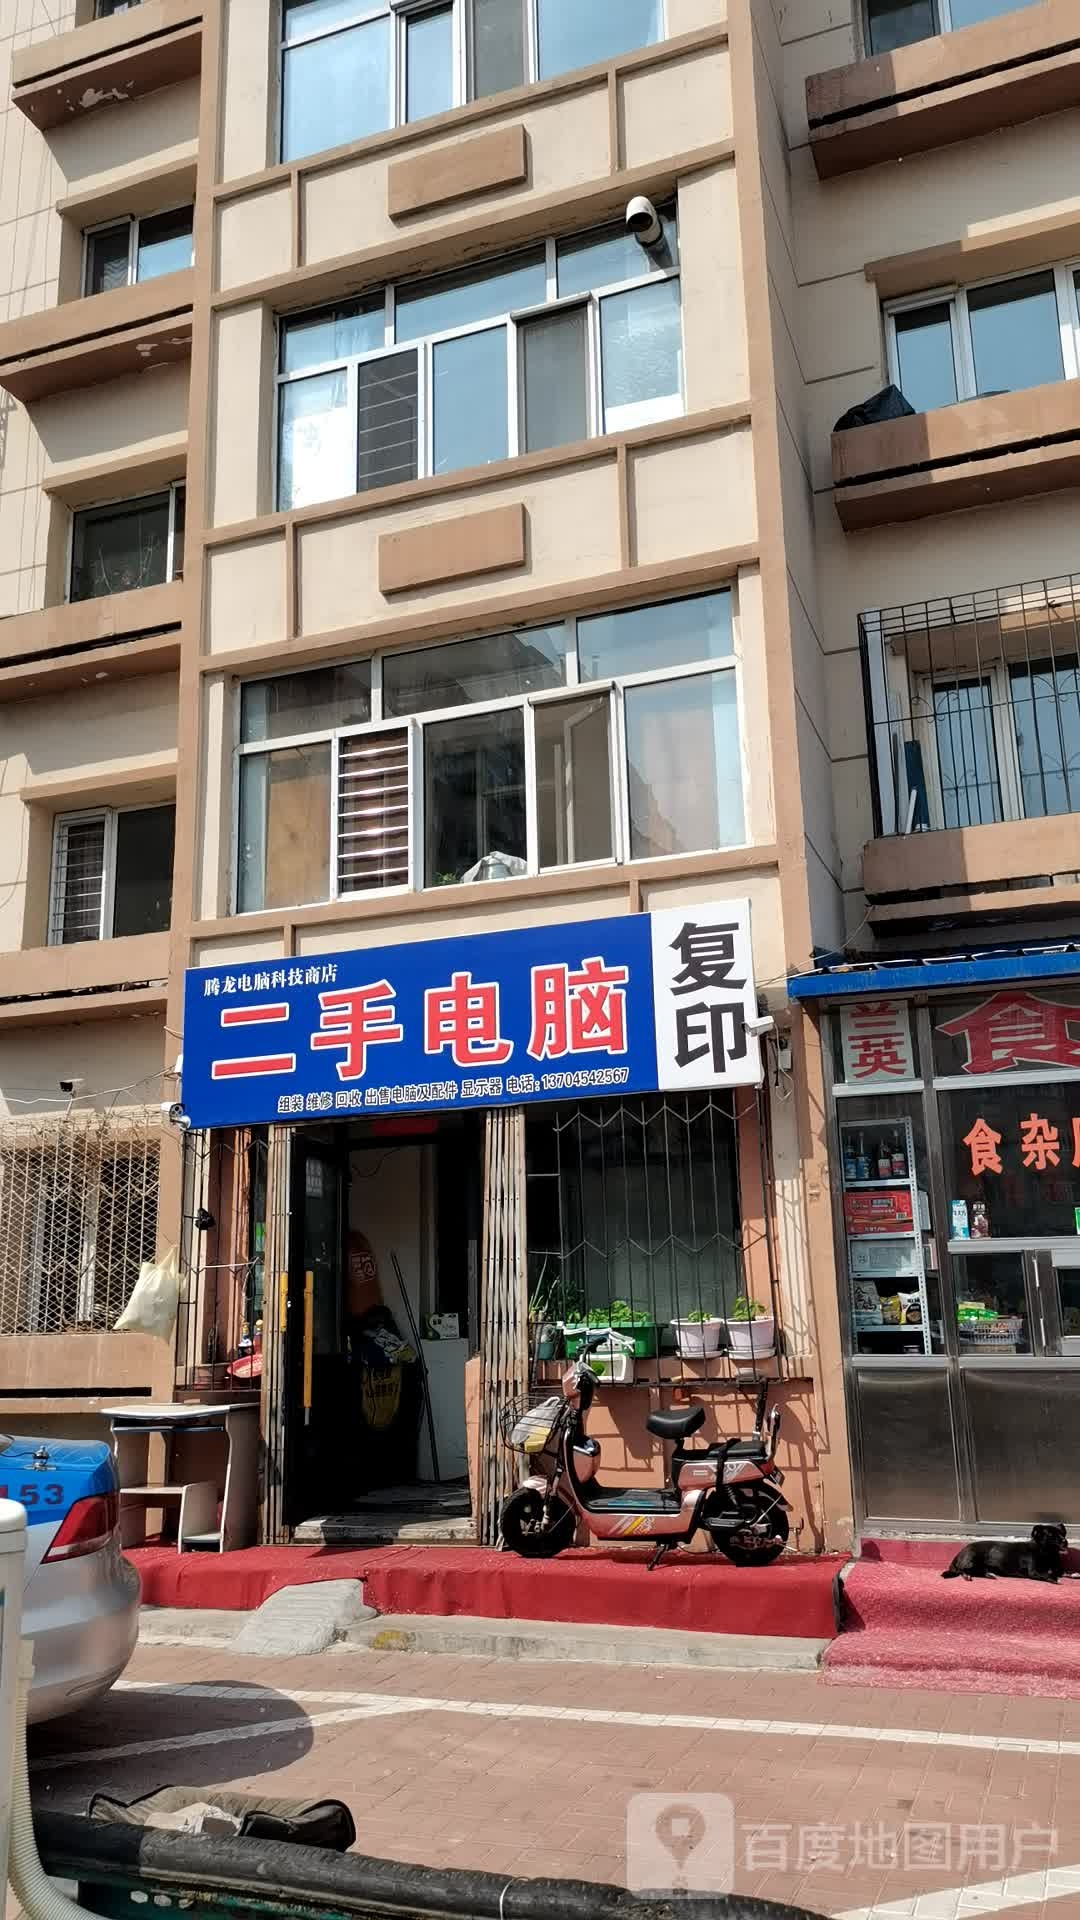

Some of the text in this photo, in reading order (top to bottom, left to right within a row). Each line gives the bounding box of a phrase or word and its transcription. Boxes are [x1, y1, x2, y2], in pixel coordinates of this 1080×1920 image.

[204, 964, 338, 997] 腾龙电脑科技商店
[669, 922, 747, 1072] 复印
[211, 956, 631, 1081] 二手电脑
[278, 1095, 302, 1112] 组装
[307, 1091, 332, 1109] 维修
[335, 1089, 361, 1107] 回收
[365, 1080, 457, 1106] 出售电脑及配件
[461, 1077, 502, 1098] 显示器
[962, 1112, 1080, 1176] 食杂
